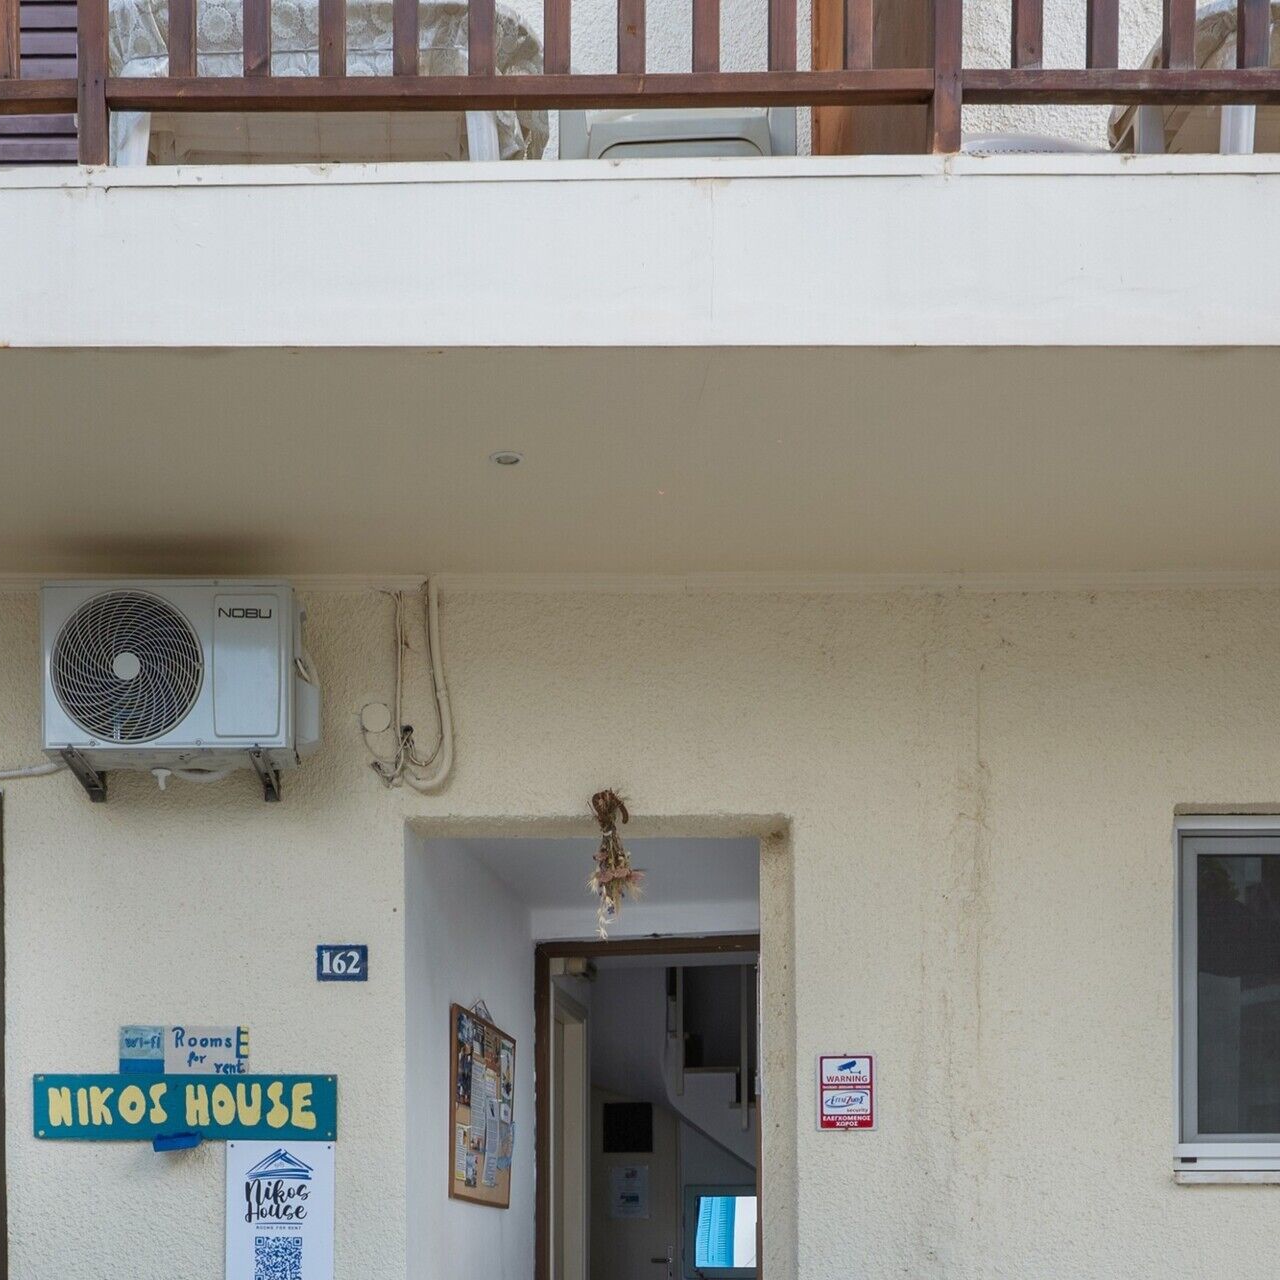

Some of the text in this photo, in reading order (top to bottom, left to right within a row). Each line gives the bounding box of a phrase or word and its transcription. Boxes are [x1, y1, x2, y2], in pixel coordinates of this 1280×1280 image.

[218, 607, 271, 618] NOBU
[322, 950, 360, 973] 162
[172, 1027, 232, 1048] Rooms
[187, 1051, 207, 1067] for
[214, 1060, 246, 1074] rent
[48, 1081, 316, 1130] NIKOS HOUSE
[245, 1179, 311, 1205] Nikos
[245, 1201, 308, 1223] House
